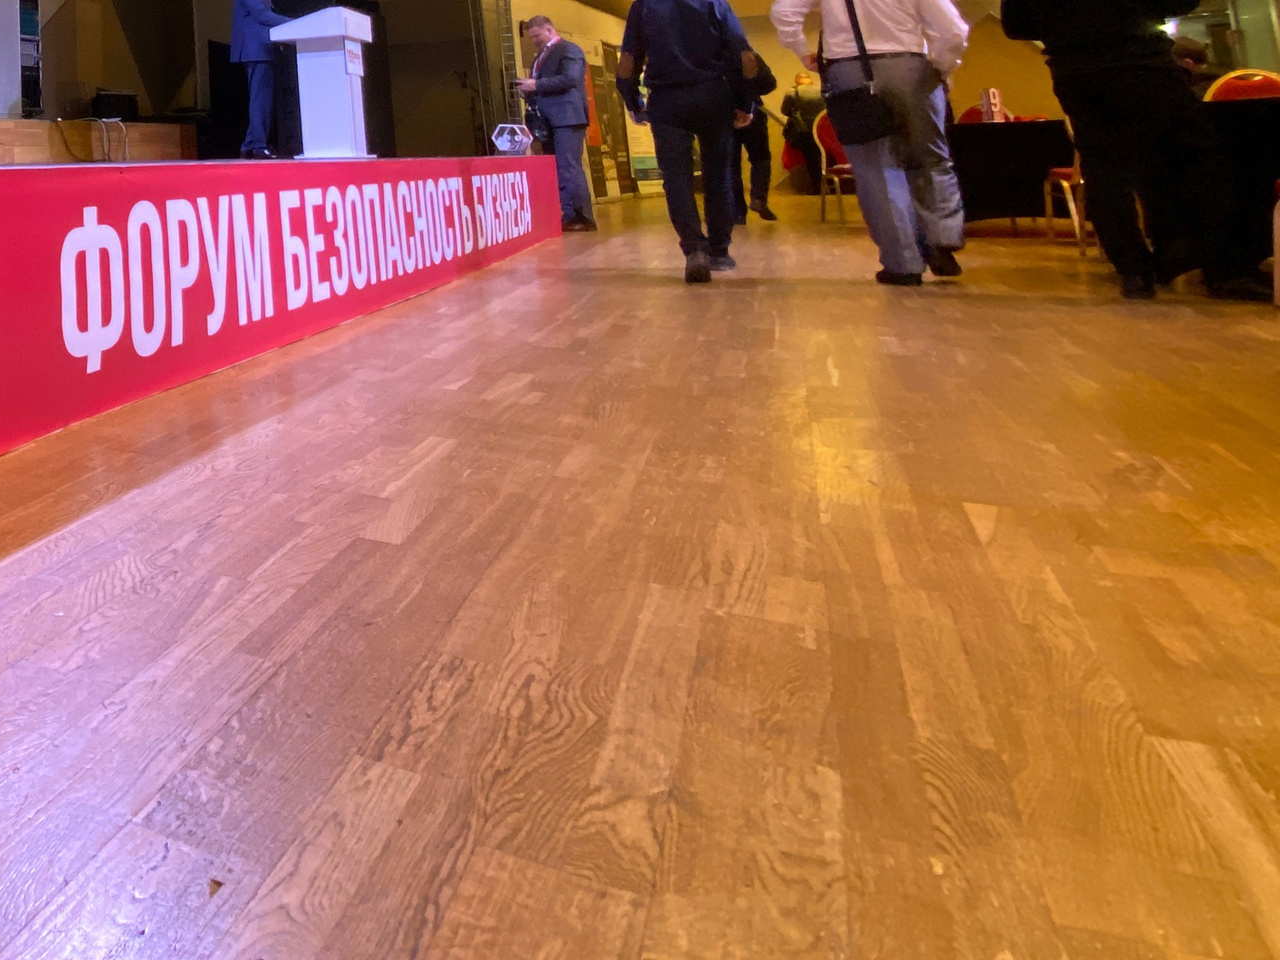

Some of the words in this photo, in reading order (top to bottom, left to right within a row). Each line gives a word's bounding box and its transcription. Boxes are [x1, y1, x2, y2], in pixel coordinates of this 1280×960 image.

[60, 192, 274, 375] ФОРУМ
[279, 177, 473, 311] БЕЗОПАСНОСТЬ
[472, 171, 532, 250] БИЗНЕСА
